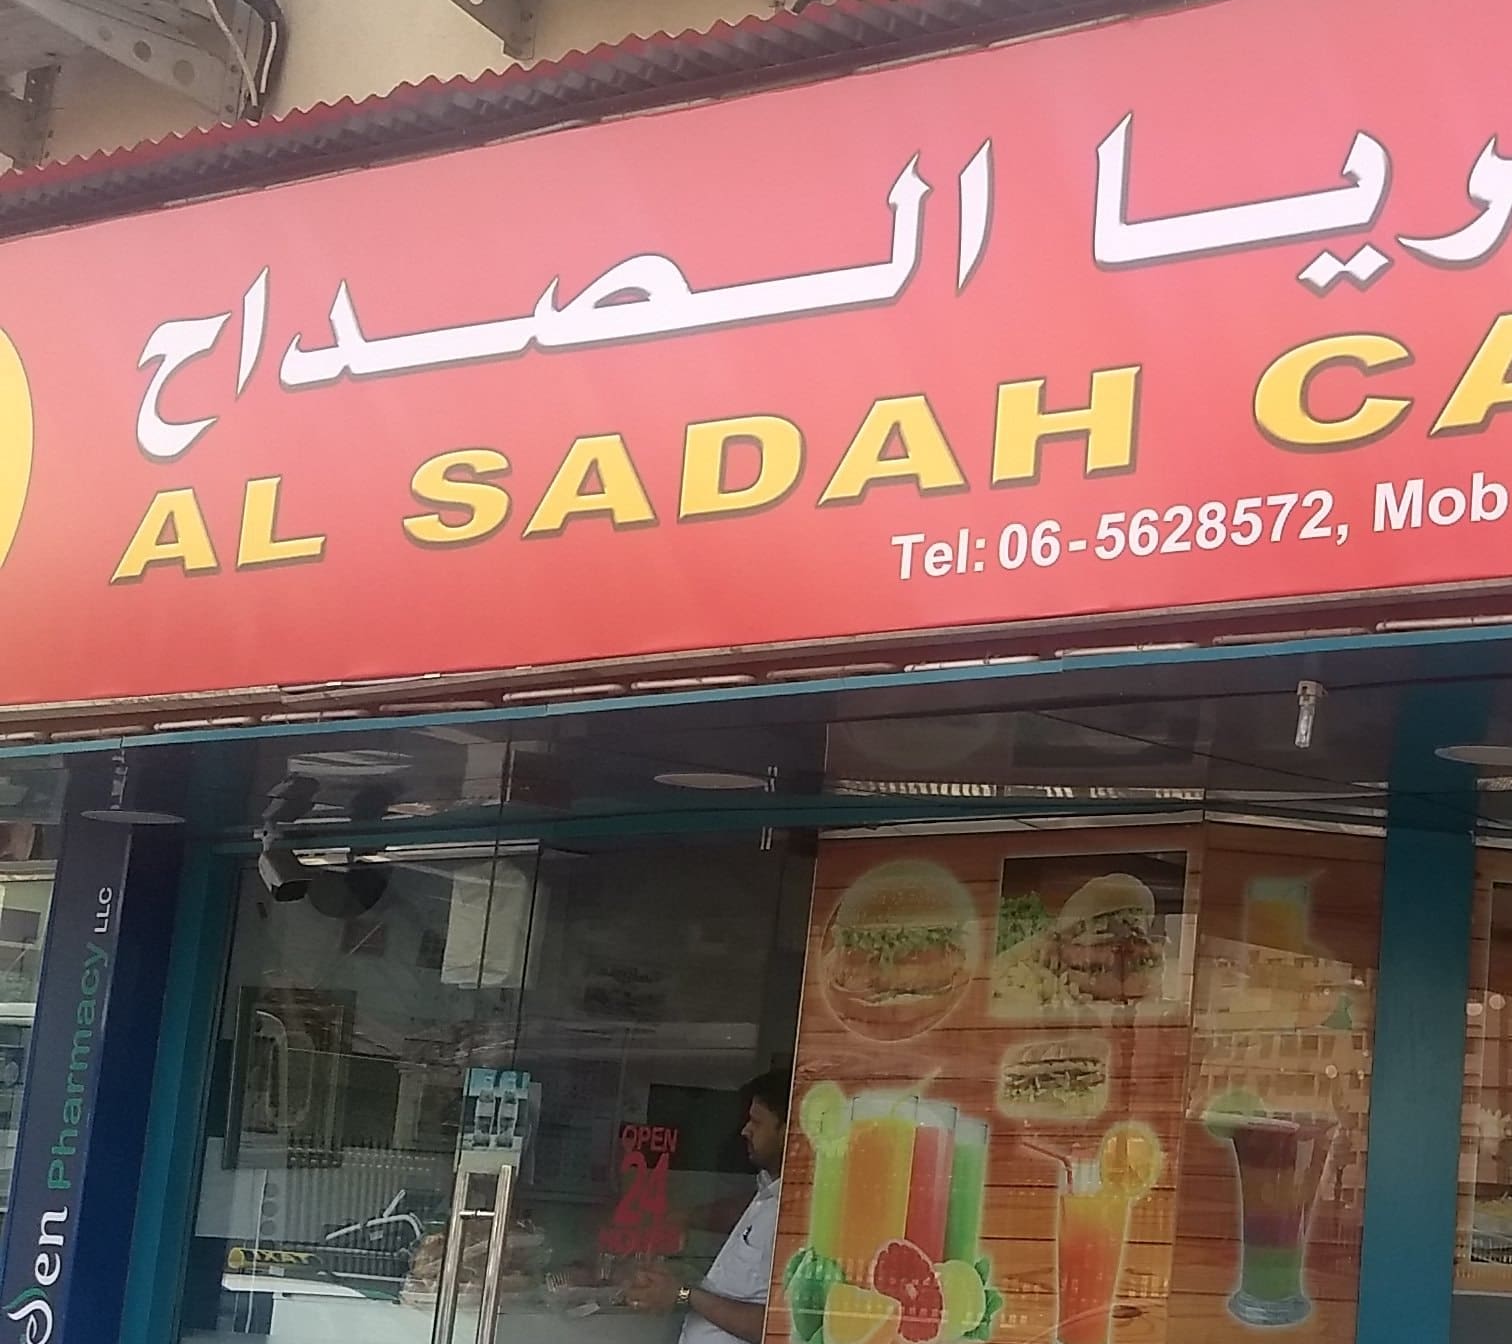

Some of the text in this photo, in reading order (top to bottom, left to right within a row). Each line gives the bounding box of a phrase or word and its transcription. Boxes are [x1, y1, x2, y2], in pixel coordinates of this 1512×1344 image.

[135, 138, 993, 460] الصداح
[110, 476, 327, 582] AL
[402, 366, 1140, 544] SADAH
[890, 532, 986, 580] Tel:
[47, 941, 109, 1191] Pharmacy
[94, 886, 113, 934] LLC
[622, 1124, 678, 1153] OPEN
